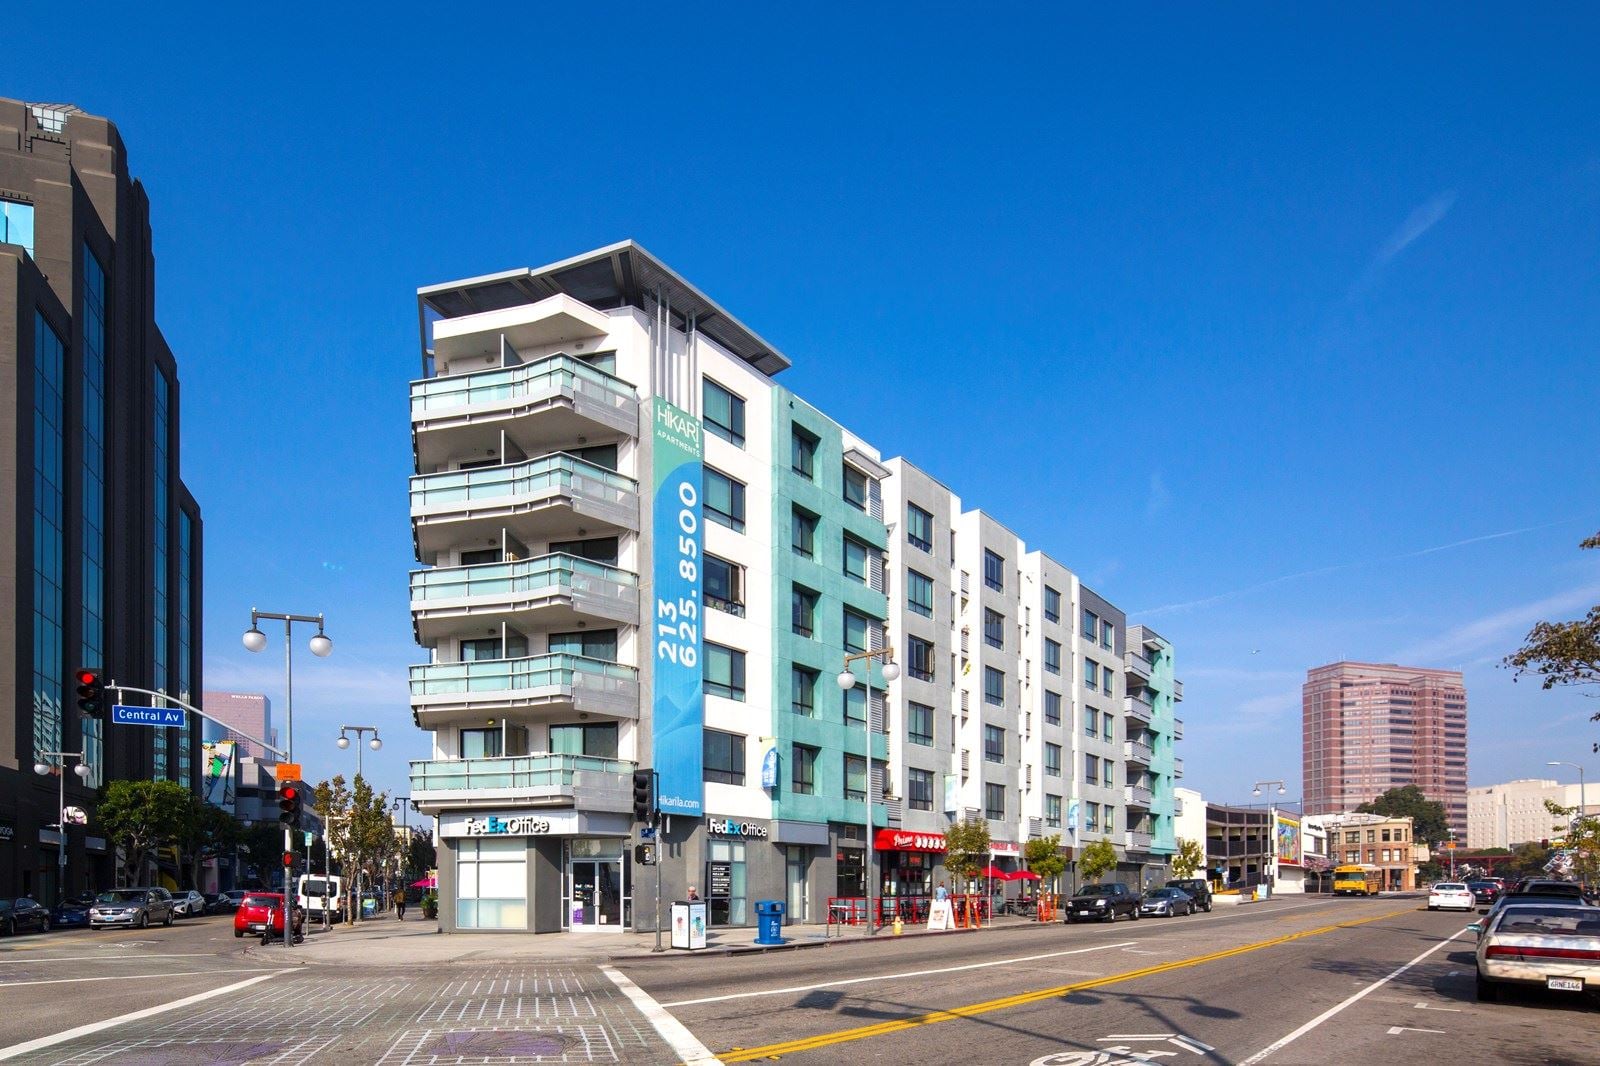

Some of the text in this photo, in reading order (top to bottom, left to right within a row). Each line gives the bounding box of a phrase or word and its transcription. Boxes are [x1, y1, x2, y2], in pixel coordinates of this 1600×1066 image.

[657, 430, 701, 458] APARTMENTS
[658, 599, 677, 664] 213
[119, 709, 179, 722] Central Av
[464, 816, 549, 834] FedEx Office
[709, 818, 768, 837] FedEx Office
